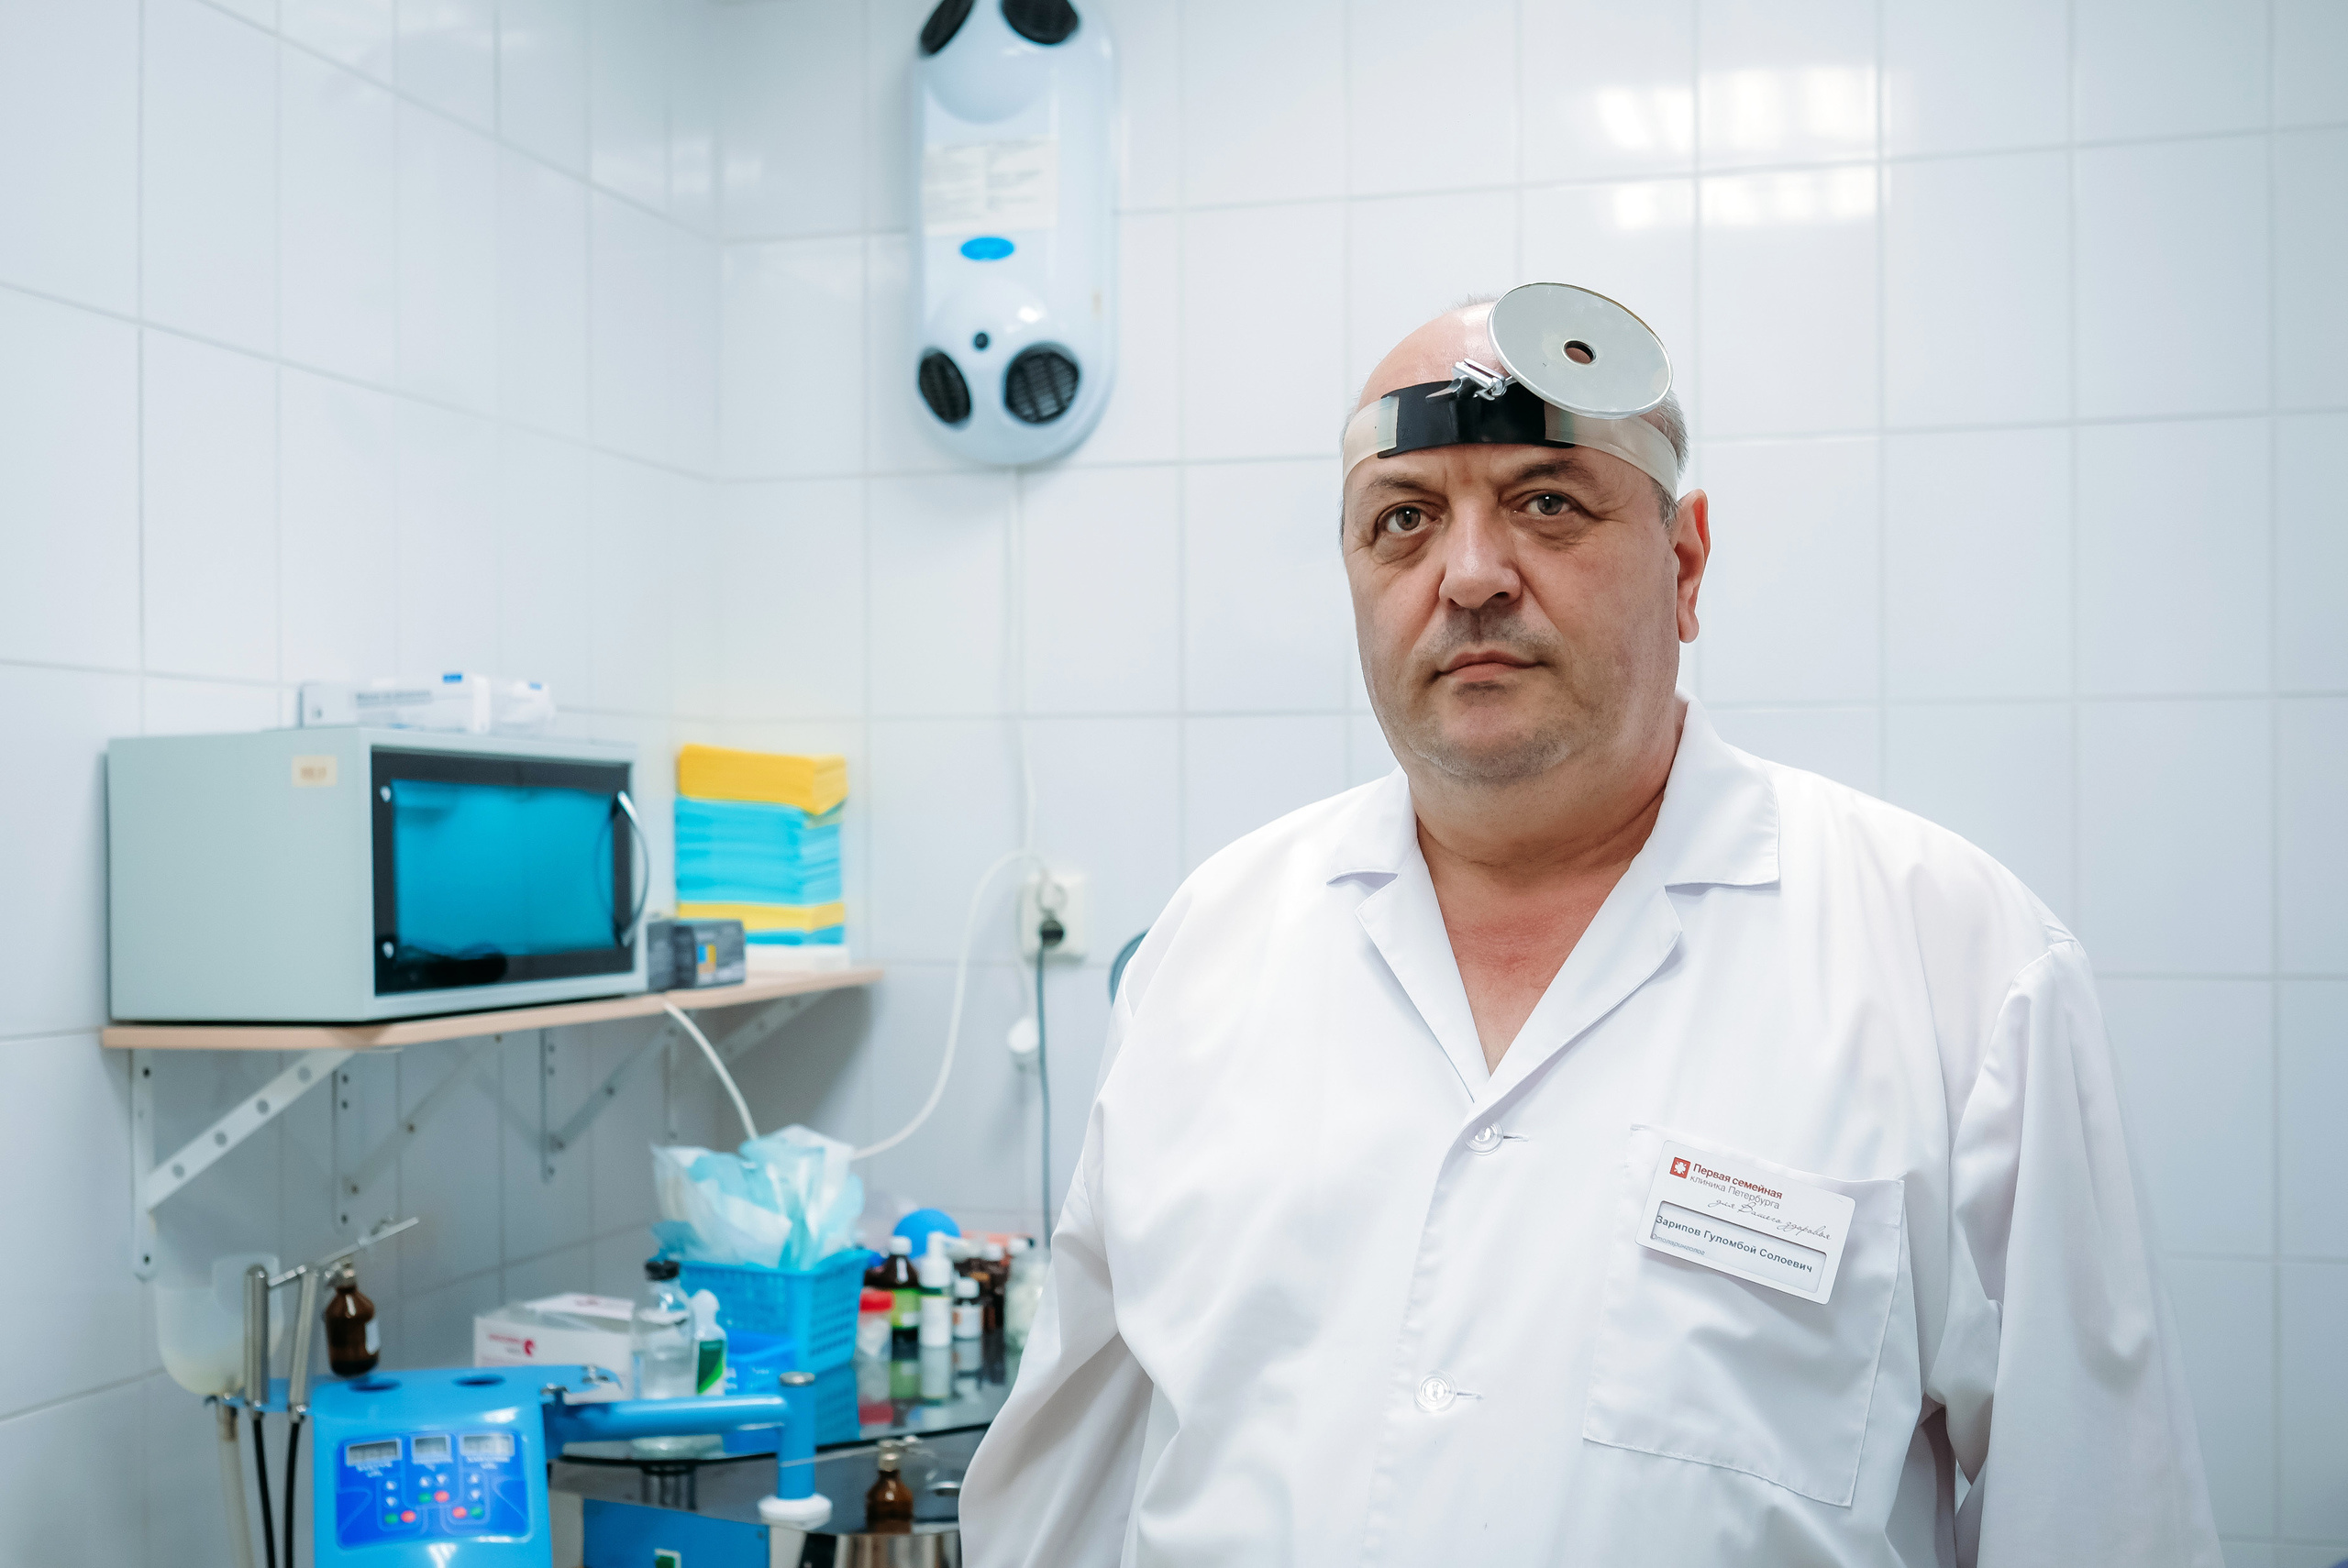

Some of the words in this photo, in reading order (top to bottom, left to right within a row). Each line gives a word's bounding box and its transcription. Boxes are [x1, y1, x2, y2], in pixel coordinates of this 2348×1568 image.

[1689, 1176, 1726, 1192] клиника
[1728, 1186, 1779, 1209] Петербурга
[1693, 1163, 1731, 1183] Первая
[1732, 1177, 1783, 1199] семейная
[1656, 1215, 1701, 1237] Зарипов
[1703, 1230, 1756, 1254] Гуломбой
[1759, 1248, 1812, 1273] Солоевич
